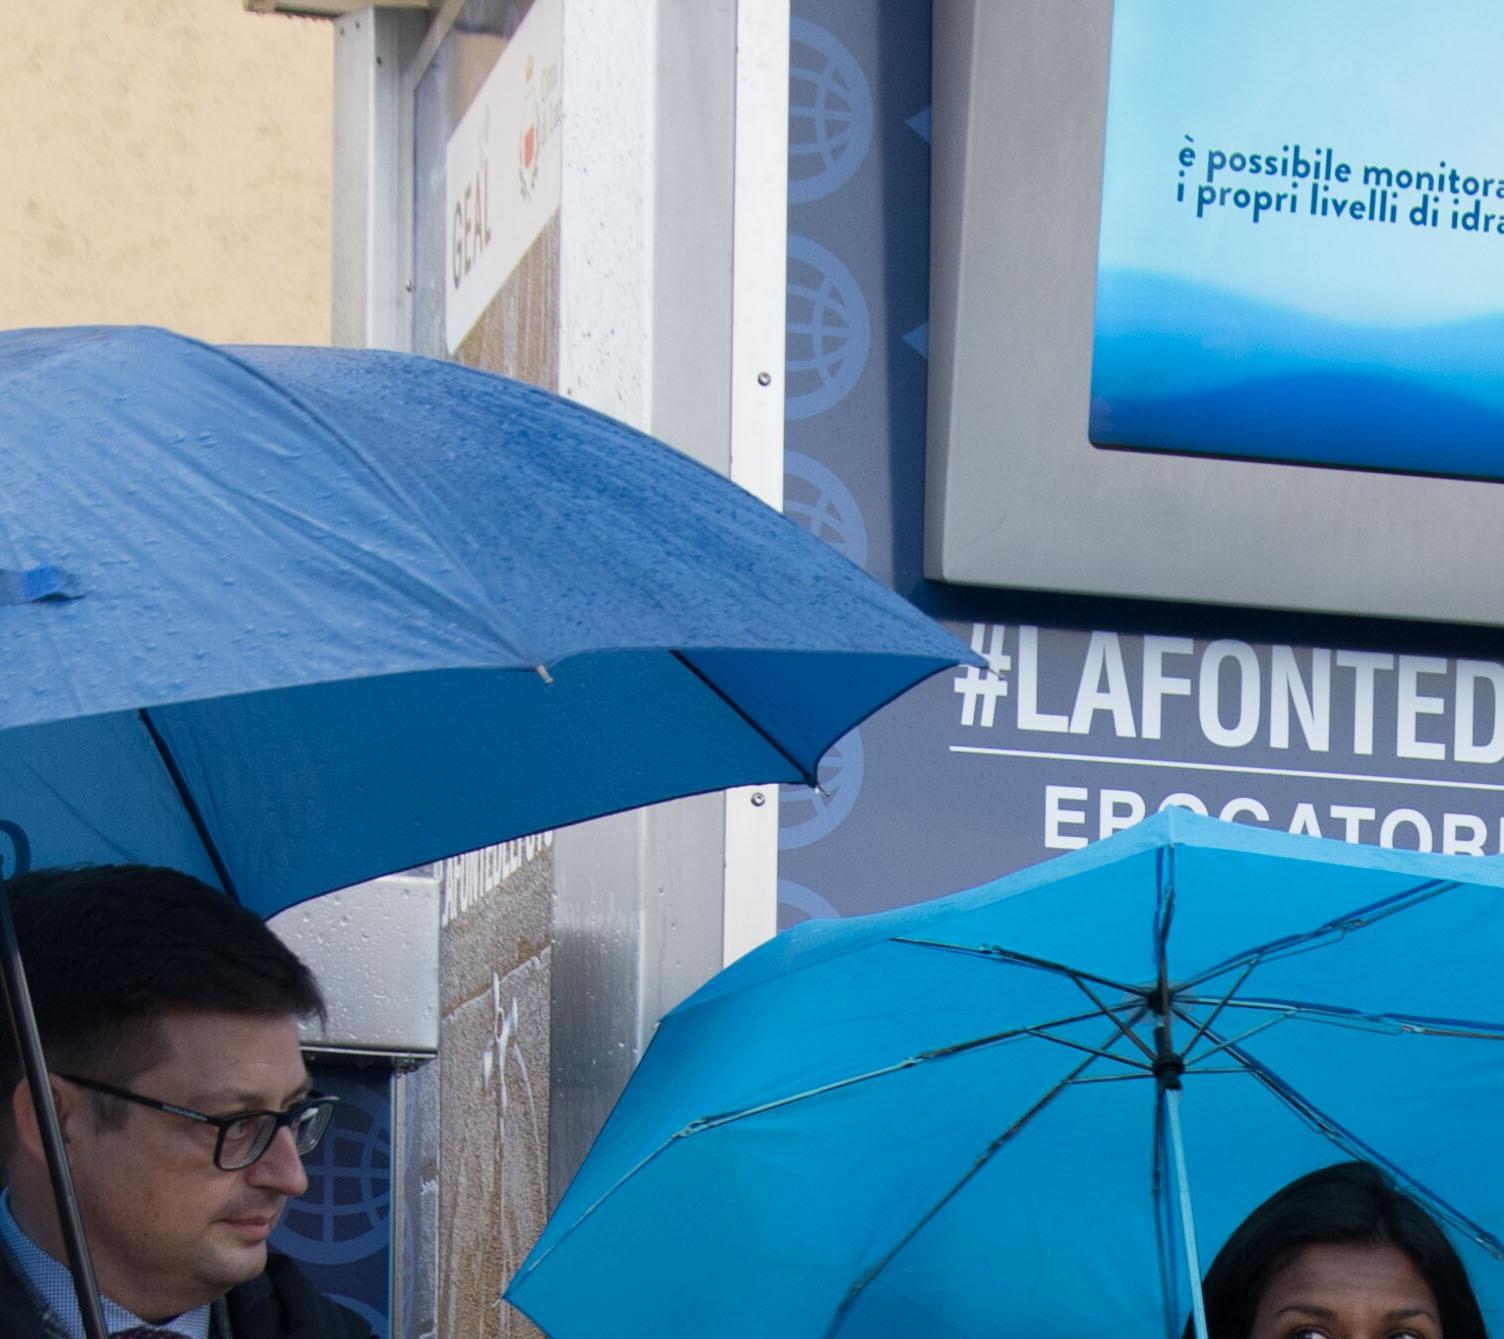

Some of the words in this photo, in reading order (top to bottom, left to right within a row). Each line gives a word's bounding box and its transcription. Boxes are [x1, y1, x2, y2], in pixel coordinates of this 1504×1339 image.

[1178, 134, 1196, 167] è
[1206, 144, 1352, 184] possibile
[452, 157, 492, 291] GEAL
[1176, 170, 1186, 203] i
[1196, 181, 1299, 223] propri
[1309, 183, 1399, 225] livelli
[1408, 198, 1440, 229] di
